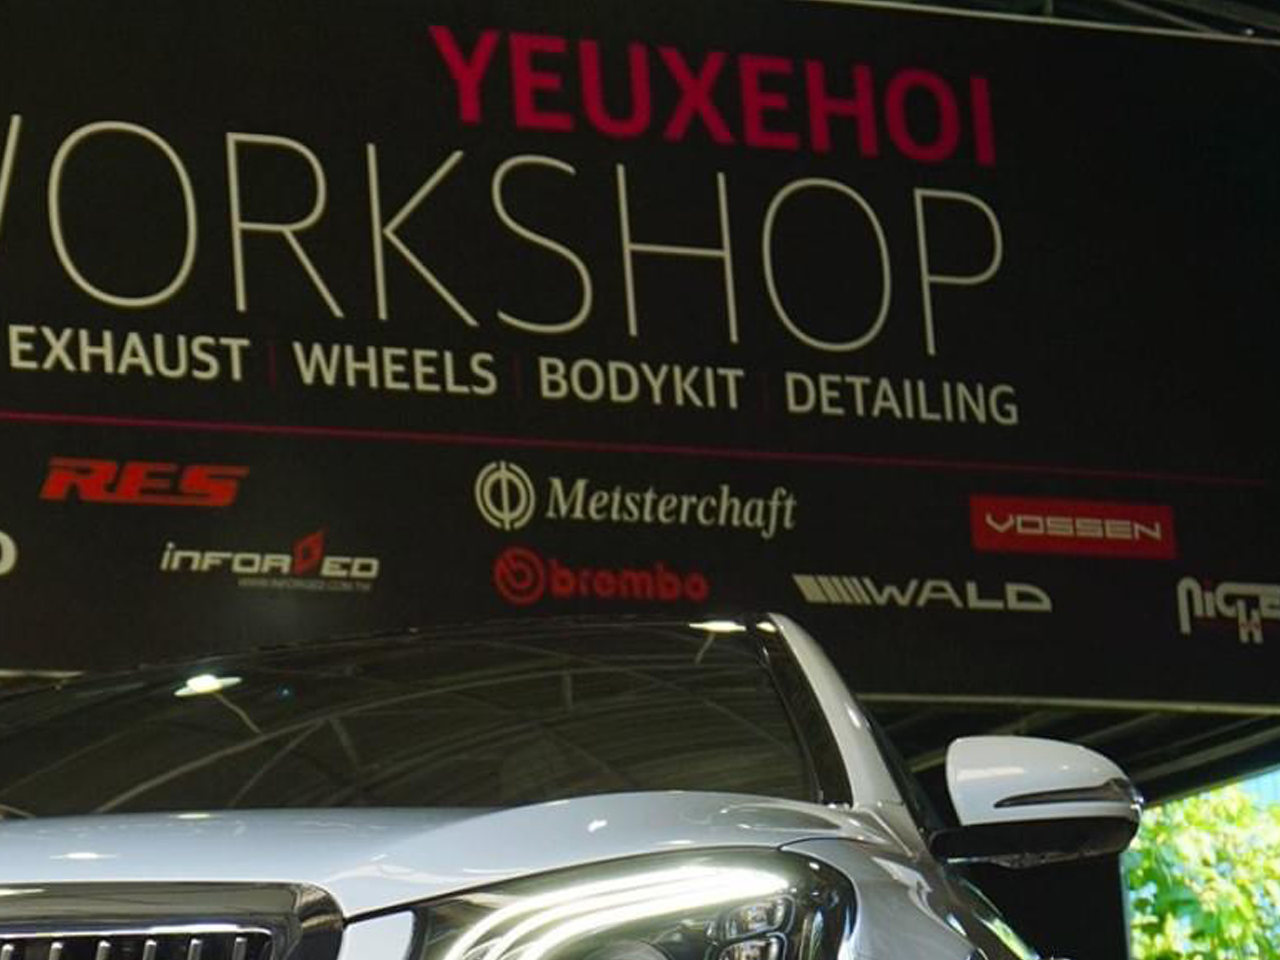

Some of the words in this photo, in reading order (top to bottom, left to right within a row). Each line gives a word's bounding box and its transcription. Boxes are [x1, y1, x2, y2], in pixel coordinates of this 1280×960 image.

[429, 26, 995, 166] YEUXEHOI
[10, 325, 249, 381] EXHAUST
[294, 342, 498, 395] WHEELS
[539, 356, 743, 410] BODYKIT
[786, 373, 1019, 424] DETAILING
[41, 456, 248, 507] RES
[547, 478, 796, 539] Meisterchaft
[985, 513, 1162, 540] VOSSEN
[547, 560, 709, 601] brembo
[866, 577, 1053, 612] WALD
